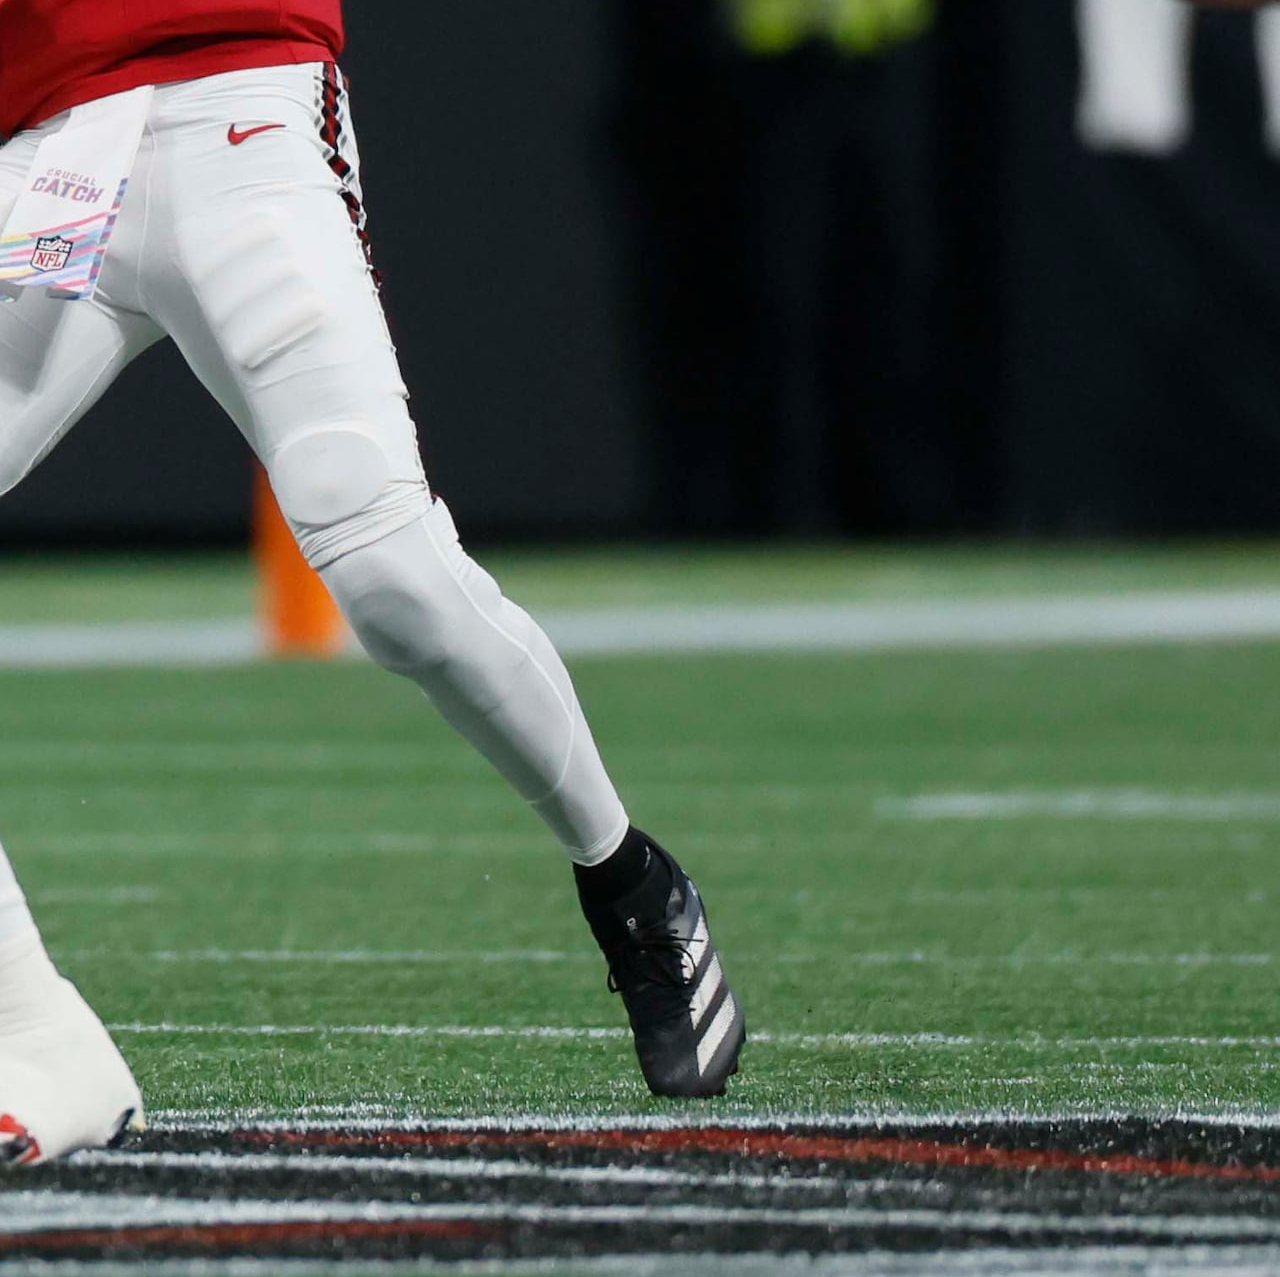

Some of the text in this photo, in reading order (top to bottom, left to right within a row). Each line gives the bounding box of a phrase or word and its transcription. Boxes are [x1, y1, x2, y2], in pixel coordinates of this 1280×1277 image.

[46, 168, 96, 186] CRUCIAL
[31, 177, 104, 204] CATCH
[34, 251, 63, 268] NFL
